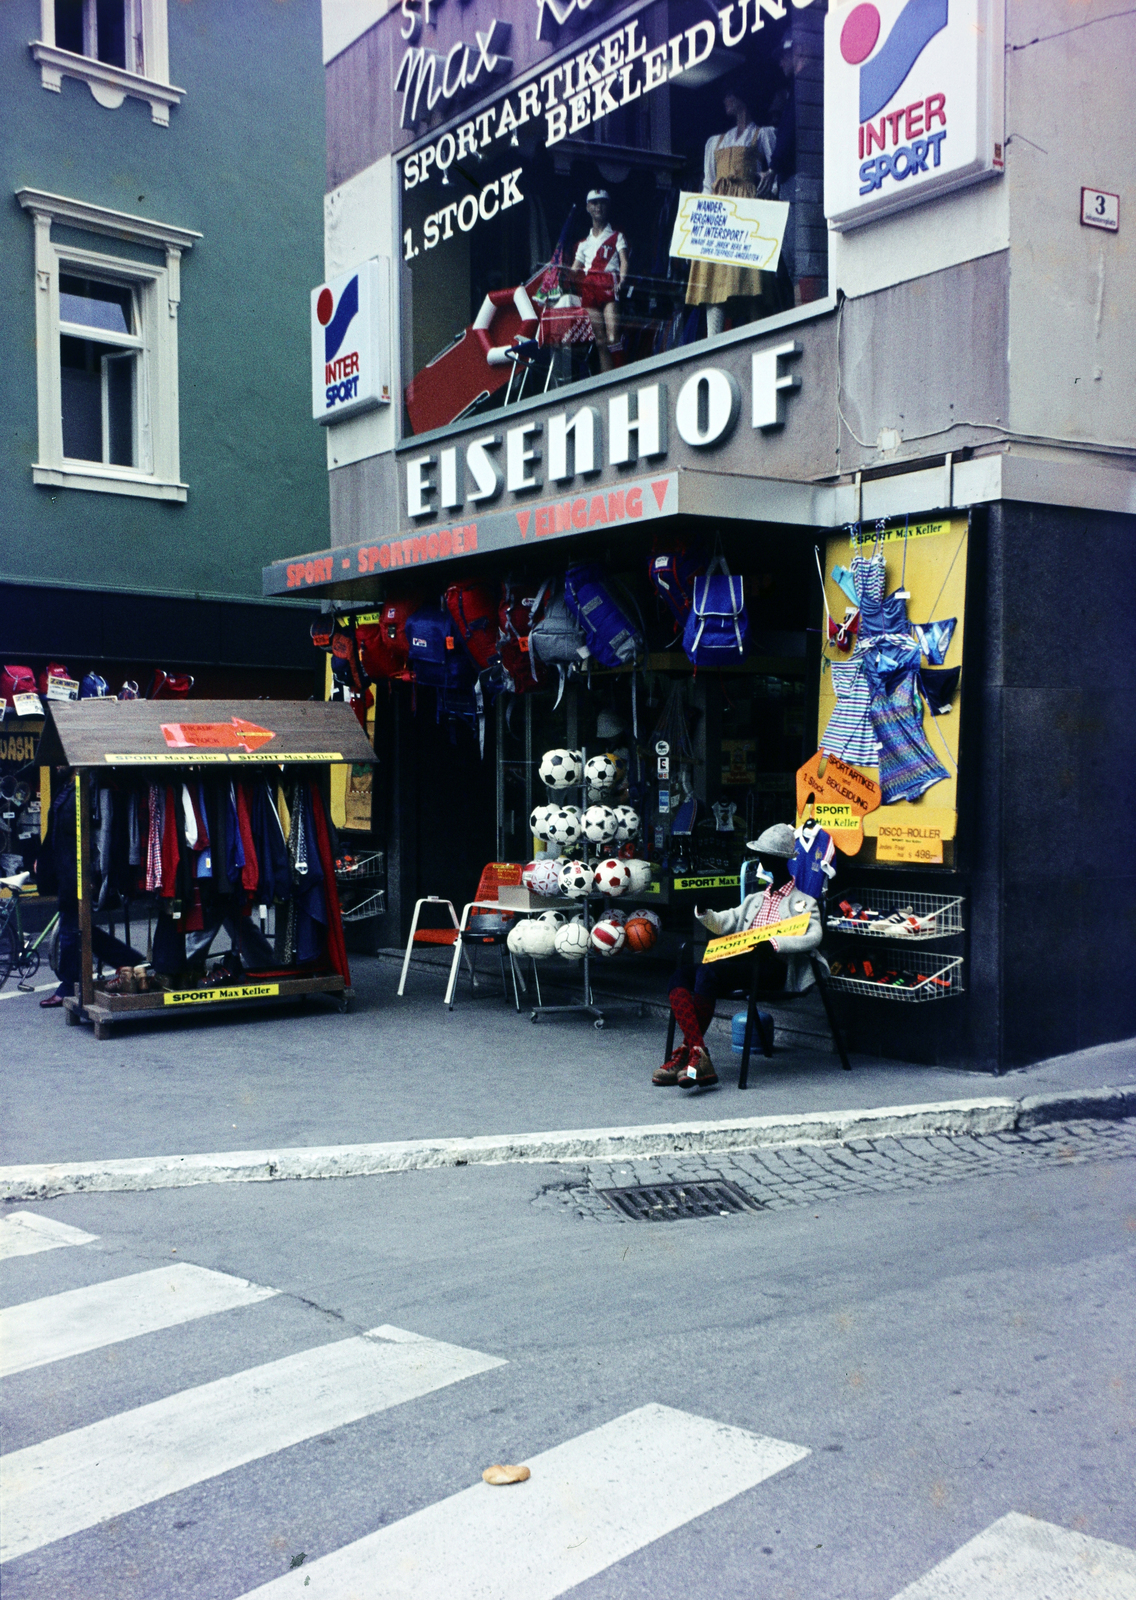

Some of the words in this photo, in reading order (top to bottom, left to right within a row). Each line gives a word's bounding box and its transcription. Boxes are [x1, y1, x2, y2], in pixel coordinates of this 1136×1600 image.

[394, 18, 499, 129] Max
[545, 0, 814, 147] BEKLEIDUN
[404, 19, 648, 190] SPORTARTIKEL
[858, 92, 947, 159] INTER
[858, 129, 947, 196] SPORT
[403, 228, 420, 261] 1.
[424, 167, 525, 250] STOCK
[1095, 195, 1106, 215] 3
[691, 225, 704, 237] MIT
[325, 351, 360, 386] INTER
[326, 375, 360, 408] SPORT
[286, 556, 334, 588] SPORT
[357, 523, 479, 574] SPORTMODEN
[534, 487, 644, 537] EINGANG
[856, 531, 893, 545] SPORT
[915, 523, 943, 536] Keller
[188, 753, 219, 761] Keller
[808, 776, 824, 795] Stock
[828, 755, 876, 794] SPORTARTIKEL
[816, 806, 850, 815] SPORT
[826, 776, 868, 811] BEKLEIDUNG
[834, 817, 858, 827] Keller
[681, 878, 716, 888] SPORT
[718, 877, 735, 886] Max
[706, 938, 752, 955] SPORT
[752, 933, 772, 942] Max
[776, 921, 807, 935] Keller
[172, 991, 215, 1002] SPORT
[219, 989, 239, 998] Max
[241, 986, 271, 997] Keller
